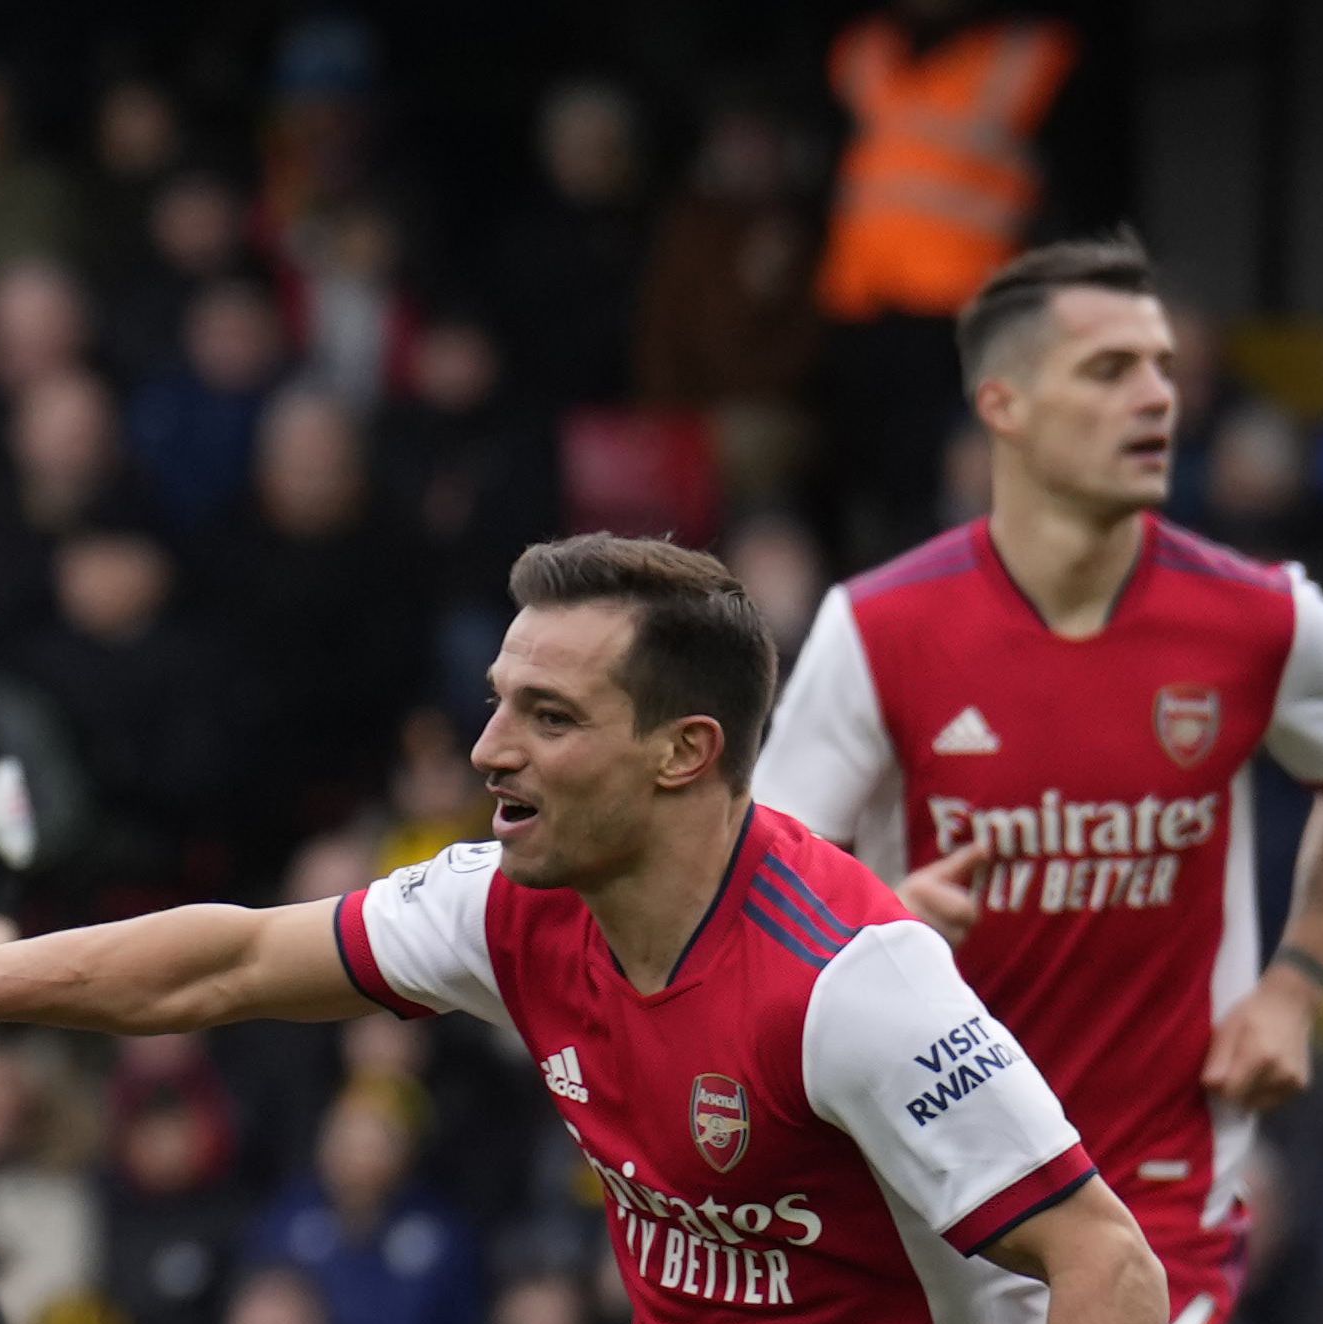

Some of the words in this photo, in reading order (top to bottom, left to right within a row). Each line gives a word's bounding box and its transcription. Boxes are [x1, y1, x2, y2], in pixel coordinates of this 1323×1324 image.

[927, 787, 1220, 859] Emirates
[1039, 854, 1181, 914] BETTER
[913, 1016, 991, 1073] VISIT
[906, 1042, 1021, 1127] RWAND
[660, 1227, 794, 1305] BETTER
